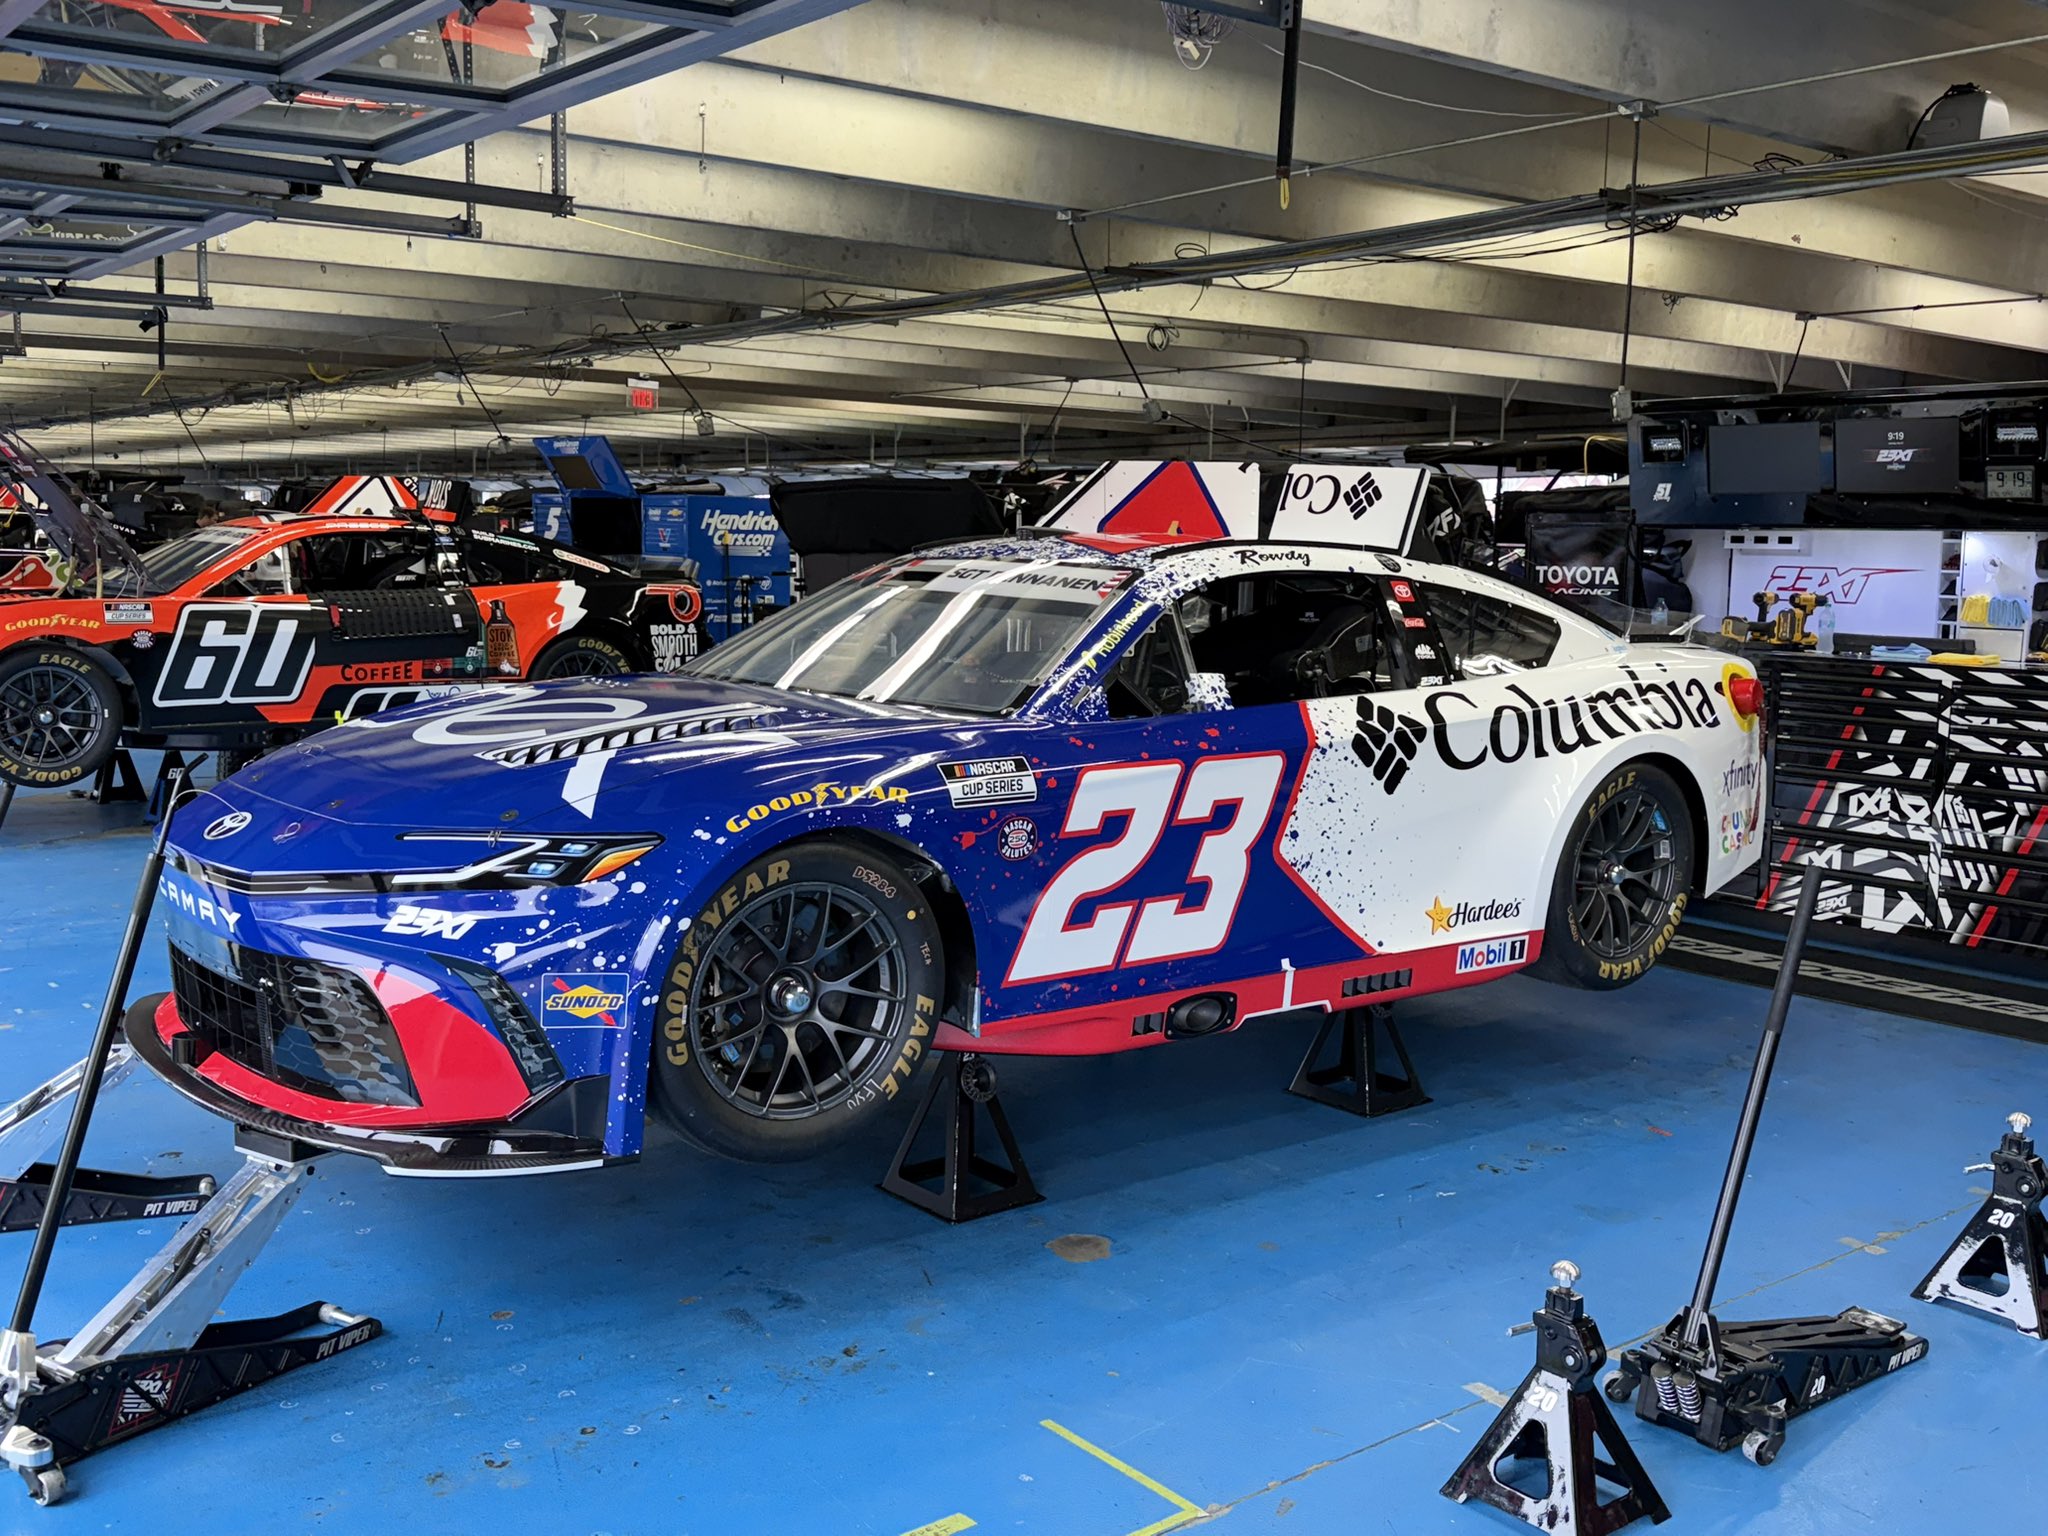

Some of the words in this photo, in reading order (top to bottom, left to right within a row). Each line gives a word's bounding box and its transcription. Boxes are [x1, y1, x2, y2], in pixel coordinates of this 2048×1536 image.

[1887, 432, 1904, 441] 9:19
[543, 507, 562, 540] 5
[713, 530, 775, 546] Crs.com
[1235, 550, 1311, 567] Rowdy
[947, 568, 990, 580] SGT
[1535, 565, 1620, 586] TOYOTA
[4, 613, 101, 632] GOODYEAR
[650, 624, 686, 635] BOLD
[687, 624, 697, 634] &
[38, 653, 92, 674] EAGLE
[153, 603, 316, 707] 60
[341, 661, 414, 682] COFFEE
[1424, 663, 1722, 771] Columbia
[968, 760, 1017, 776] NASCAR
[1722, 759, 1758, 797] xfinity
[961, 782, 984, 796] CUP
[985, 778, 1024, 794] SERIES
[1588, 771, 1637, 822] EAGLE
[725, 782, 909, 833] GOODYEAR
[1003, 819, 1033, 835] NASCAR
[1001, 841, 1033, 858] SALUTES
[1001, 750, 1287, 989] 23
[852, 865, 897, 899] D5284
[160, 875, 241, 935] CAMRY
[1447, 897, 1522, 928] Hardee's
[664, 859, 791, 1066] GOODYEAR
[1458, 941, 1508, 970] Mobil
[1512, 941, 1523, 960] 1
[550, 995, 622, 1011] SUNOCO
[881, 993, 935, 1101] EAGLE
[144, 1203, 163, 1216] PIT
[165, 1200, 199, 1214] VIPER
[1987, 1208, 2014, 1228] 20
[316, 1339, 337, 1359] PIT
[338, 1327, 372, 1351] VIPER
[1887, 1352, 1902, 1371] PIT
[1901, 1343, 1923, 1365] VIPER
[1810, 1375, 1826, 1397] 20
[1527, 1387, 1556, 1412] 20
